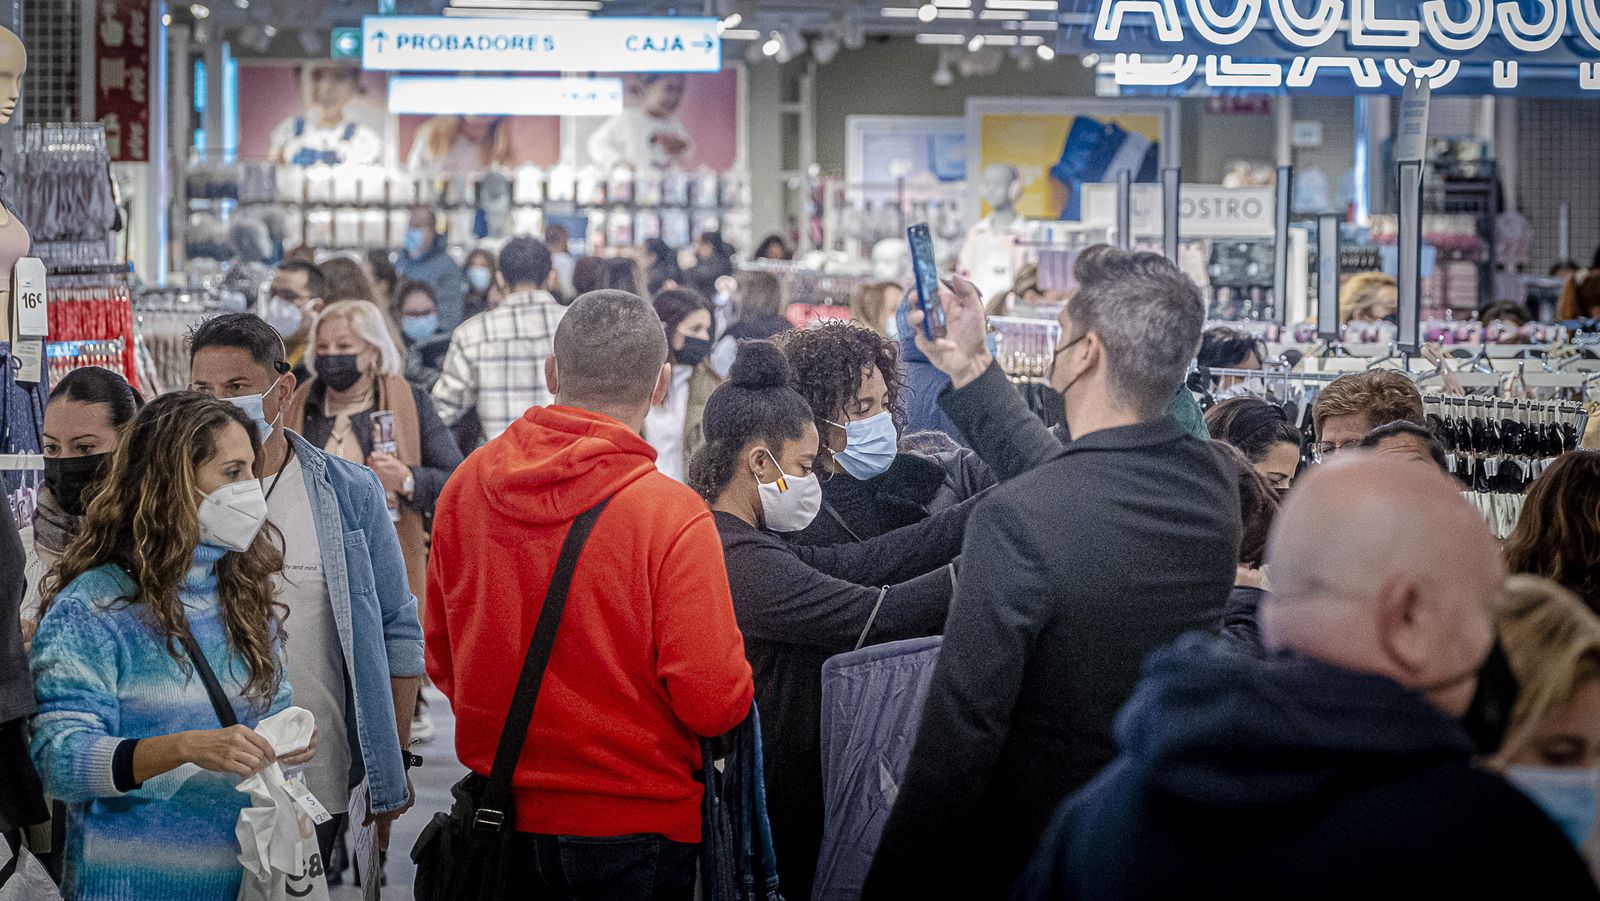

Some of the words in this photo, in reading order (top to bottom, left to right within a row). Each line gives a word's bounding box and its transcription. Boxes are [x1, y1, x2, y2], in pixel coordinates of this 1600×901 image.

[396, 33, 555, 51] PROBADORES
[625, 34, 685, 51] CAJA
[1179, 197, 1263, 220] OSTRO
